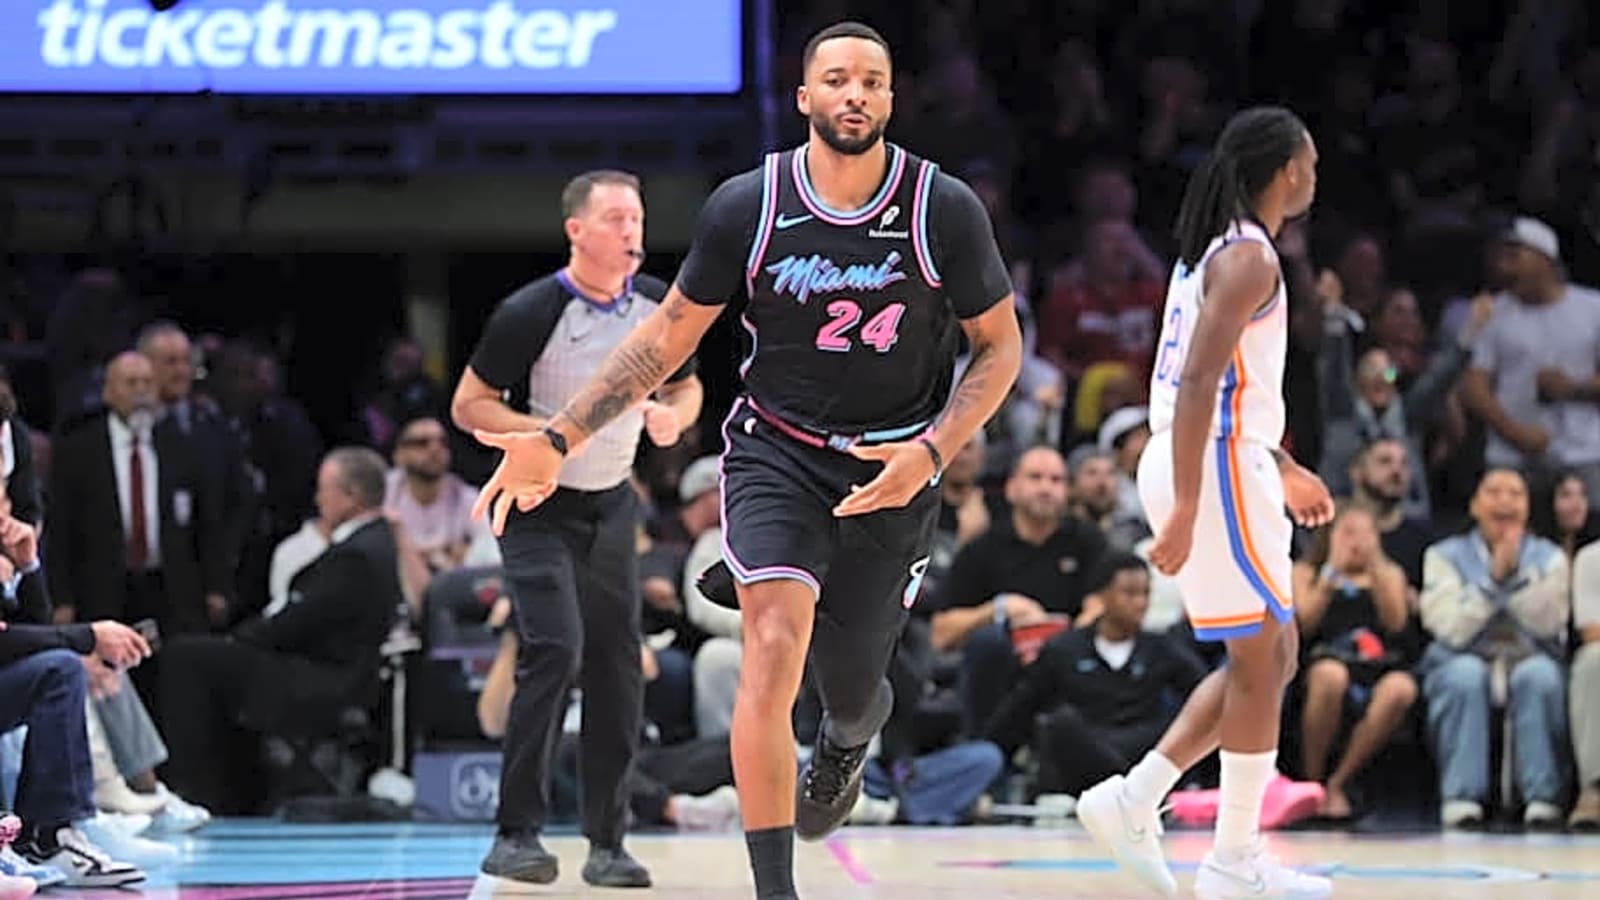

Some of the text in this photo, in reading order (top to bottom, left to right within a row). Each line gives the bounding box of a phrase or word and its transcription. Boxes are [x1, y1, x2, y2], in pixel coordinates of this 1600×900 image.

[38, 0, 615, 66] ticketmaster
[765, 251, 906, 304] Miami
[816, 300, 906, 352] 24
